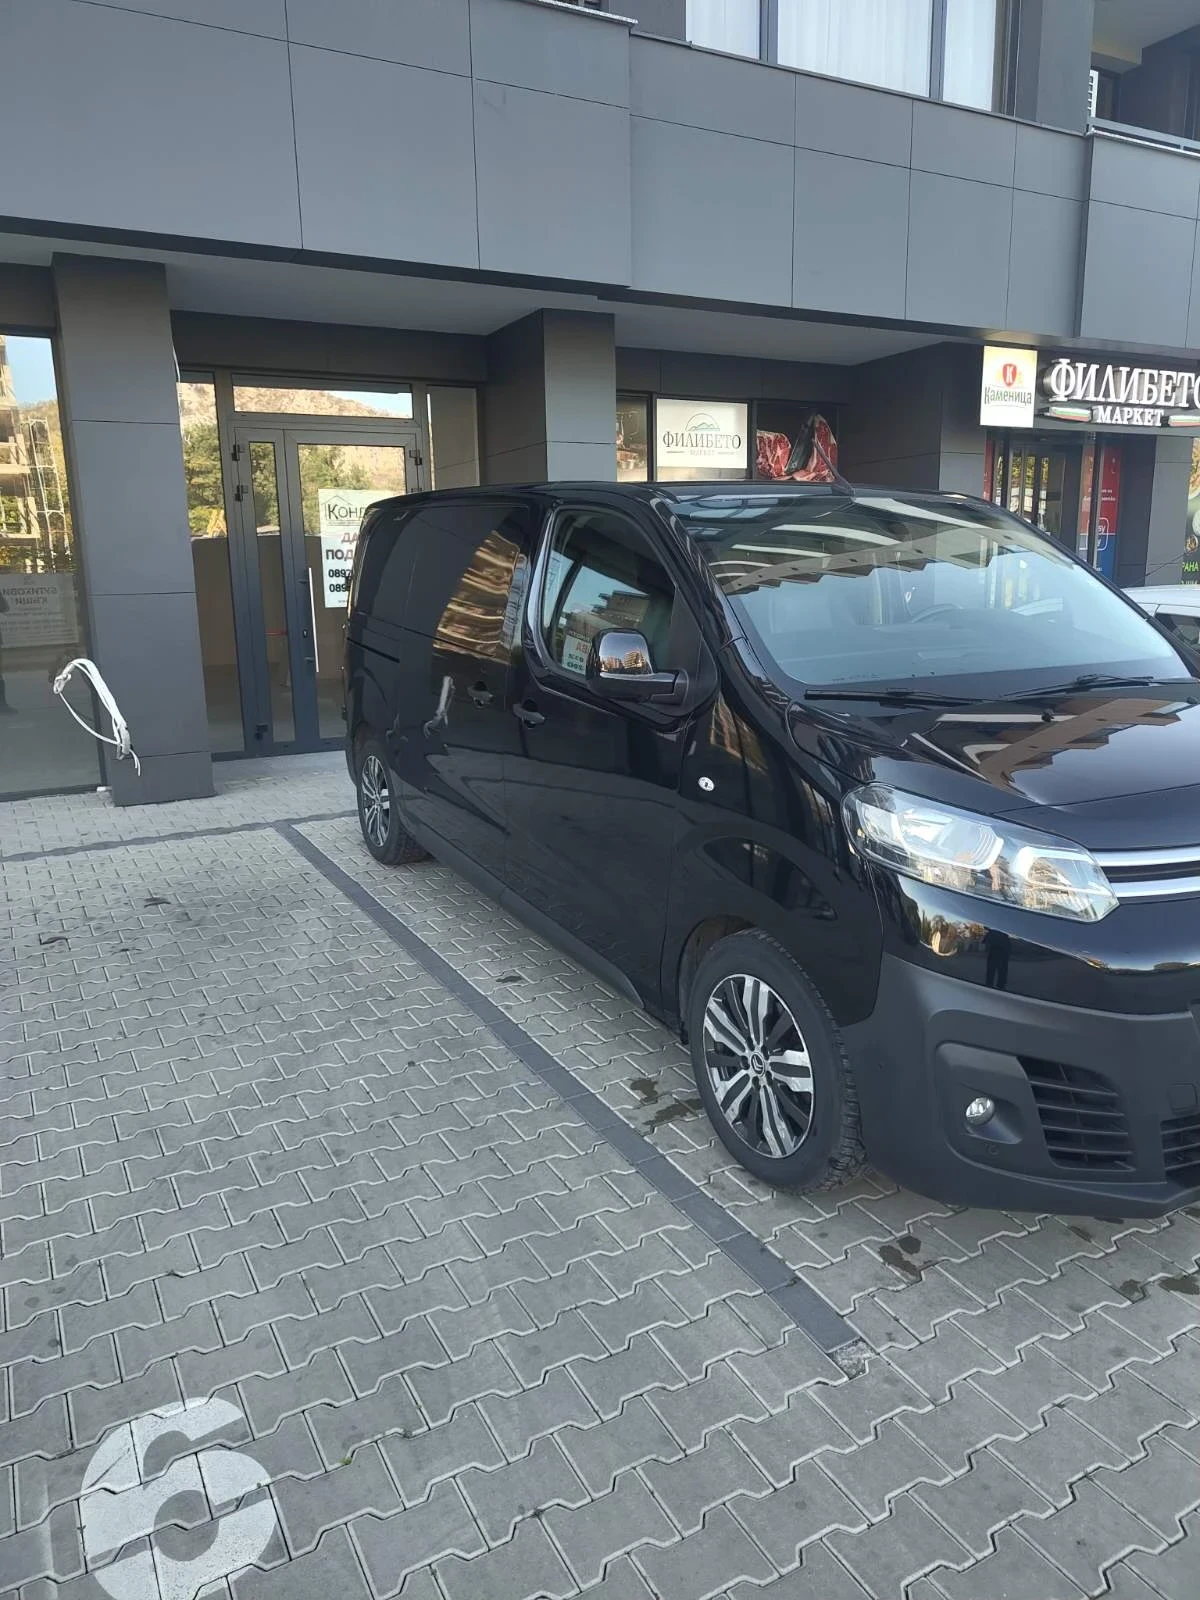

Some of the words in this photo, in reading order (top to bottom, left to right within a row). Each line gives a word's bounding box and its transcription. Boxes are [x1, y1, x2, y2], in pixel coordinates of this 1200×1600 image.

[984, 386, 1032, 405] Каменица
[1096, 405, 1164, 428] МАРКЕТ
[663, 431, 742, 449] ФИЛИБЕТО
[326, 549, 354, 561] ПОД
[80, 1397, 277, 1600] 6
